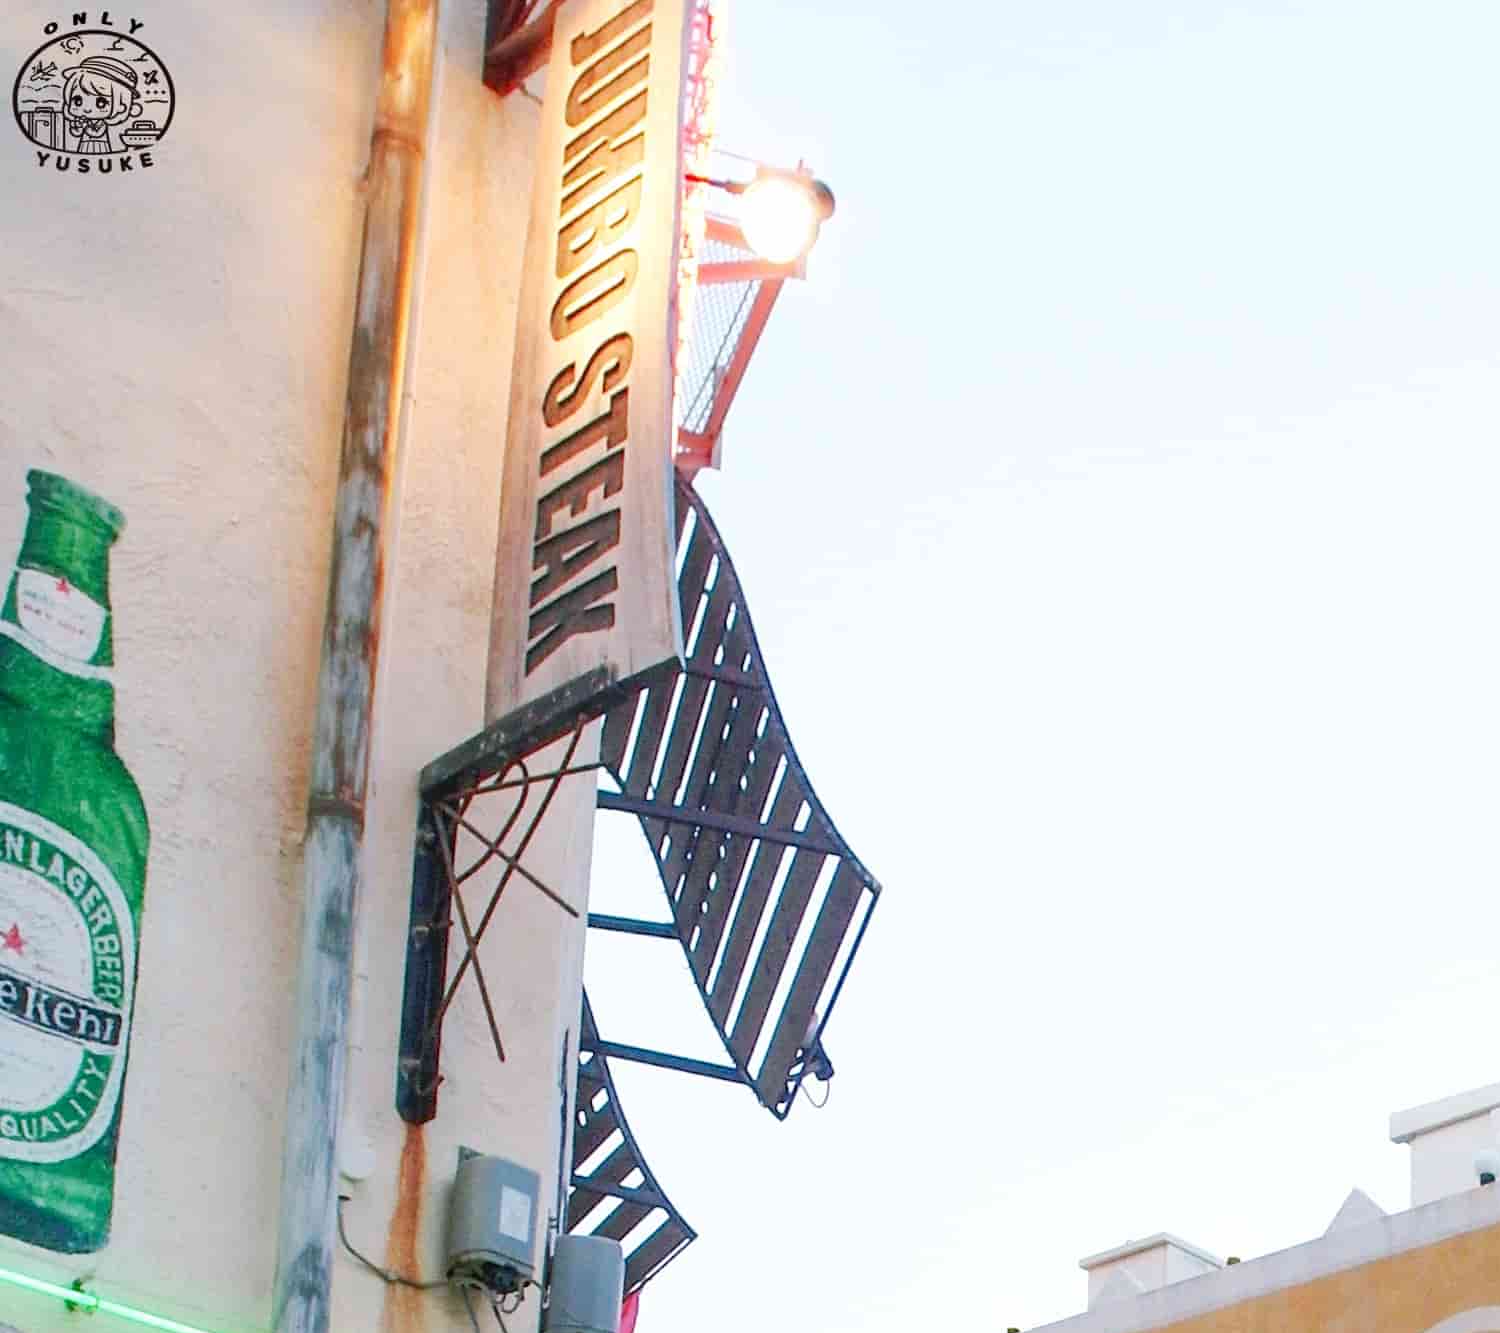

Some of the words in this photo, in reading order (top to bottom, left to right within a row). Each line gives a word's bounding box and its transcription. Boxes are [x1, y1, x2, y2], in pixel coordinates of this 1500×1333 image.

[524, 332, 634, 678] STEAK
[28, 840, 113, 935] LAGER
[92, 933, 121, 1001] BEER
[0, 1054, 107, 1140] QUALITY
